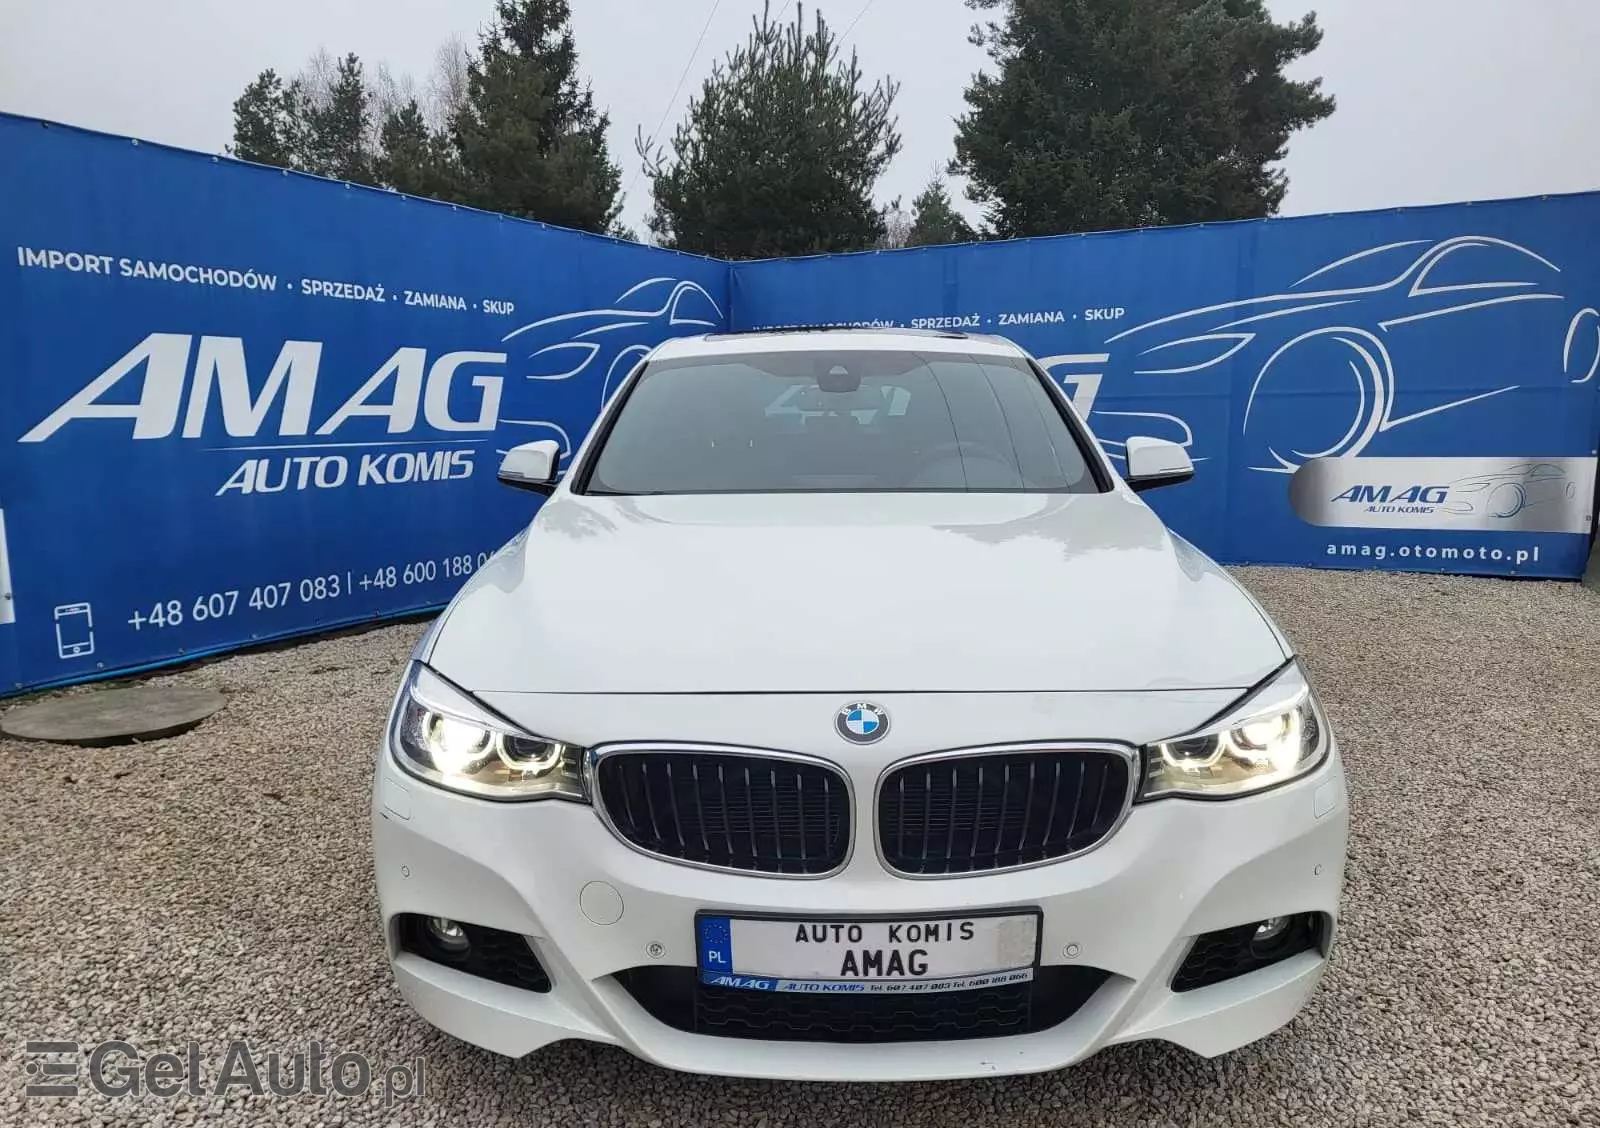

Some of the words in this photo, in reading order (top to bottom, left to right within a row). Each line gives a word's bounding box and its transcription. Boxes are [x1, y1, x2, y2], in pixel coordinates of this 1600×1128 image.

[17, 246, 113, 275] IMPORT
[119, 258, 277, 291] SAMOCHODÓW
[301, 278, 386, 303] SPRZEDAŻ
[404, 290, 467, 311] ZAMIANA
[482, 299, 515, 315] SKUP
[911, 313, 981, 329] SPRZEDAŻ
[998, 310, 1065, 326] ZAMIANA
[1084, 307, 1125, 321] SKUP
[215, 455, 348, 497] AUTO
[358, 449, 475, 485] KOMIS
[1364, 505, 1396, 513] AUTO
[1397, 505, 1435, 514] KOMIS
[1326, 543, 1540, 564] amag.otomoto.pl
[127, 599, 183, 631] +48
[192, 590, 239, 622] 607
[248, 582, 292, 611] 407
[300, 573, 341, 600] 083
[359, 571, 397, 592] +48
[403, 561, 437, 584] 600
[442, 554, 473, 578] 188
[795, 923, 862, 943] AUTO
[888, 921, 974, 943] KOMIS
[708, 950, 726, 964] PL
[840, 949, 929, 977] AMAG
[784, 983, 820, 991] AUTO
[822, 983, 865, 992] KOMIS
